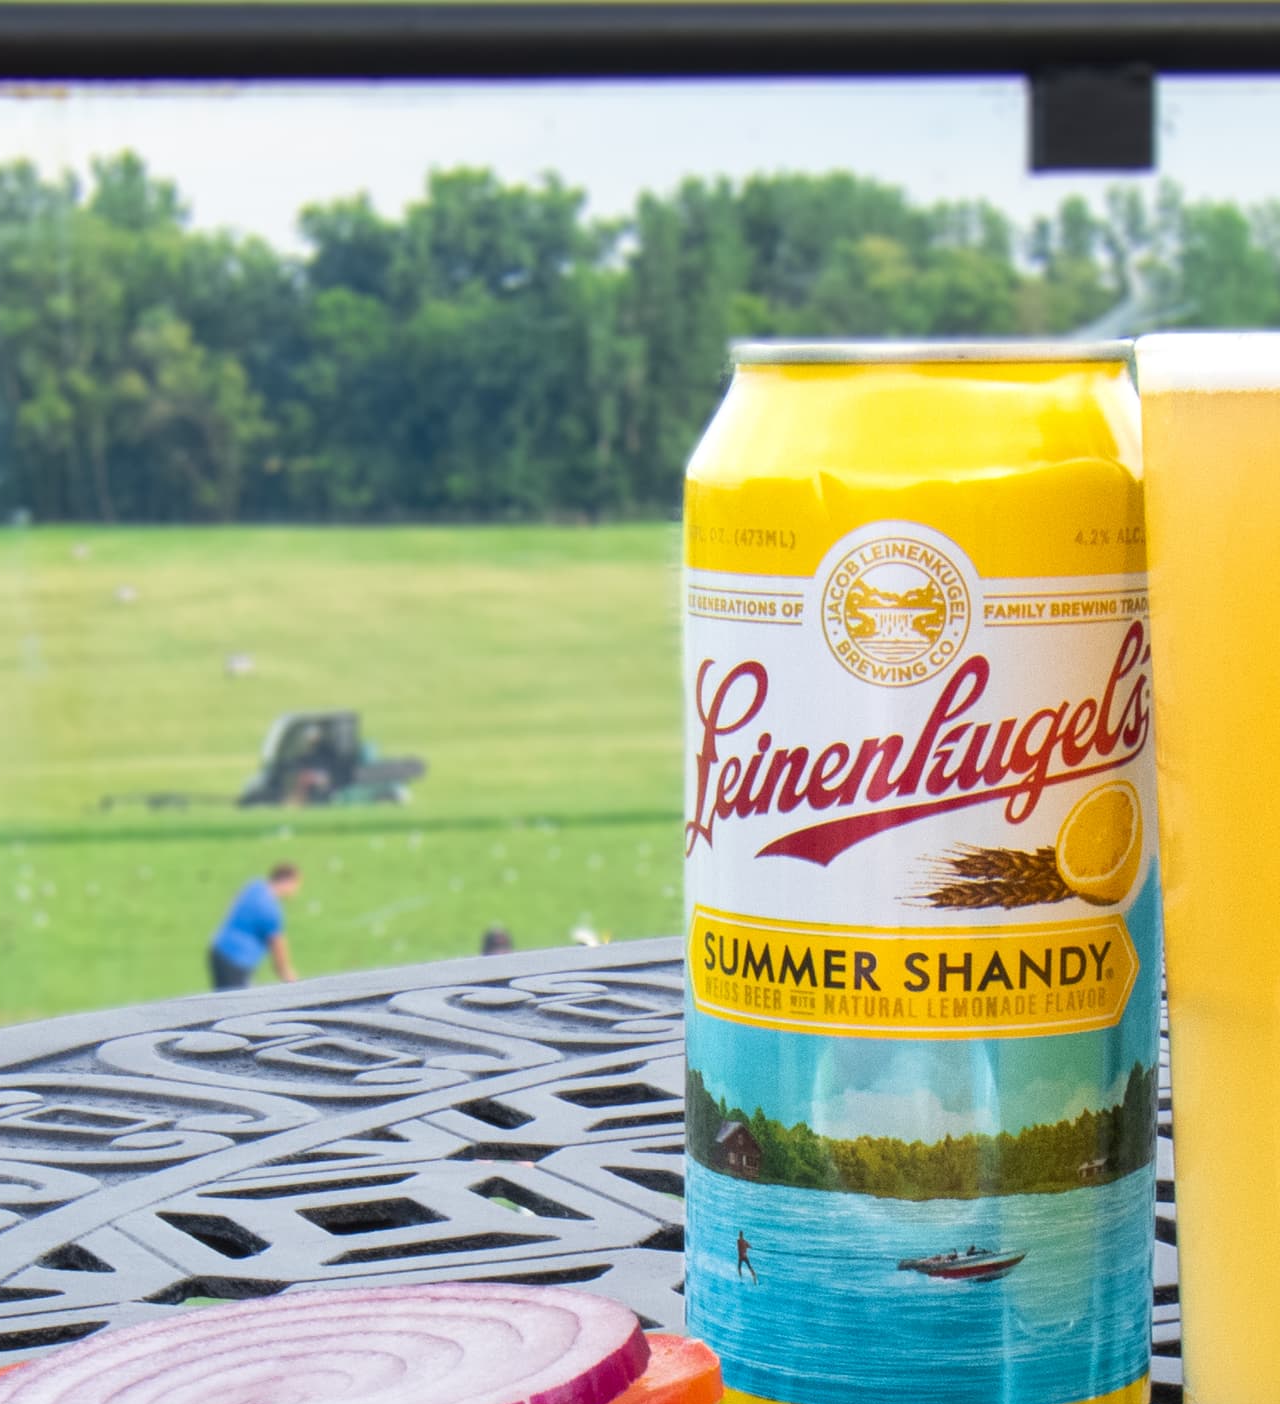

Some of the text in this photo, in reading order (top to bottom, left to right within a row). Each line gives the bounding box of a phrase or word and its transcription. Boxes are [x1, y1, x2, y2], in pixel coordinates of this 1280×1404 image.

[734, 528, 796, 550] (473ML)
[1074, 528, 1110, 545] 4.2%
[827, 543, 965, 625] JACOB LEINENKUGEL
[697, 595, 776, 616] GENERATIONS
[781, 602, 804, 617] OF
[983, 602, 1046, 619] FAMILY
[1050, 600, 1117, 617] BREWING
[836, 640, 955, 681] BREWING CO
[704, 931, 881, 992] SUMMER
[705, 976, 740, 1004] WEISS
[744, 984, 783, 1010] BEER
[823, 993, 919, 1019] NATURAL
[927, 995, 1038, 1019] LEMONADE
[1044, 987, 1107, 1014] FLAVOR
